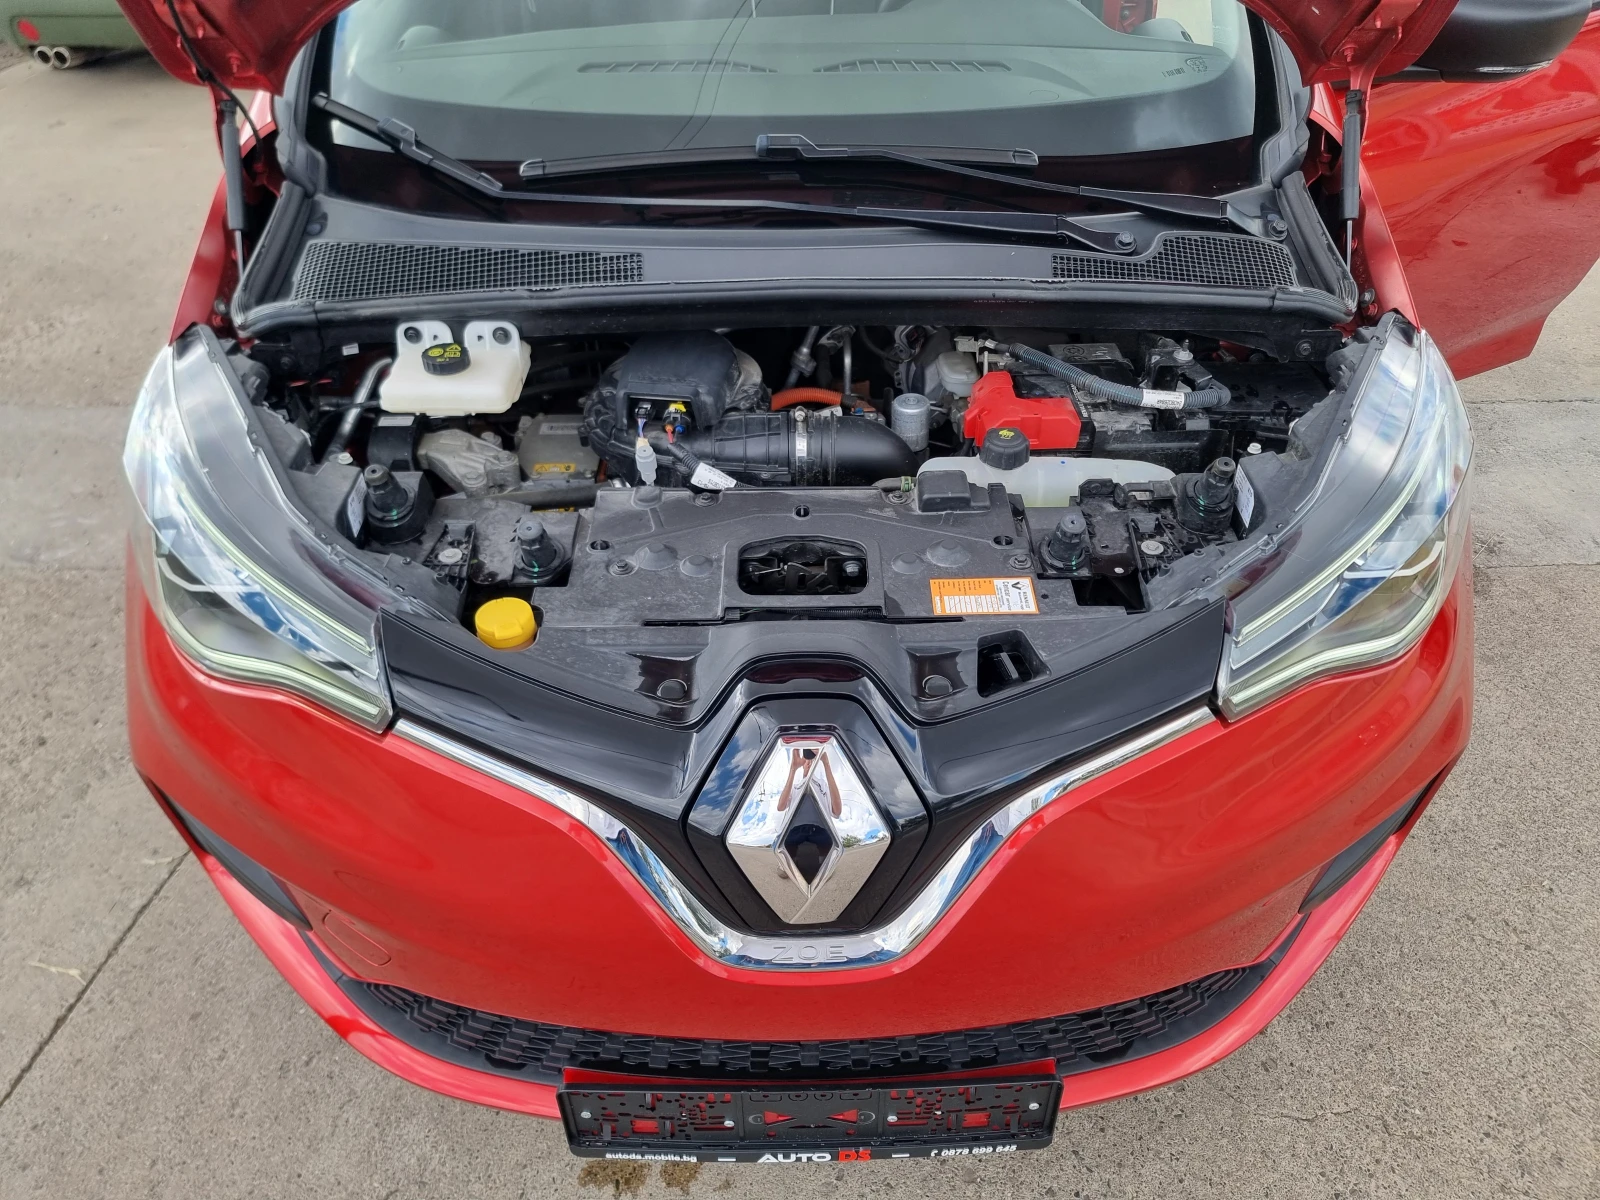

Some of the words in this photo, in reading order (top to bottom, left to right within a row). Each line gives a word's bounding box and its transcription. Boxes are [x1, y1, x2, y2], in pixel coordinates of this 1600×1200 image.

[771, 944, 848, 963] ZOE
[757, 1152, 831, 1163] AUTO
[838, 1149, 871, 1162] DS
